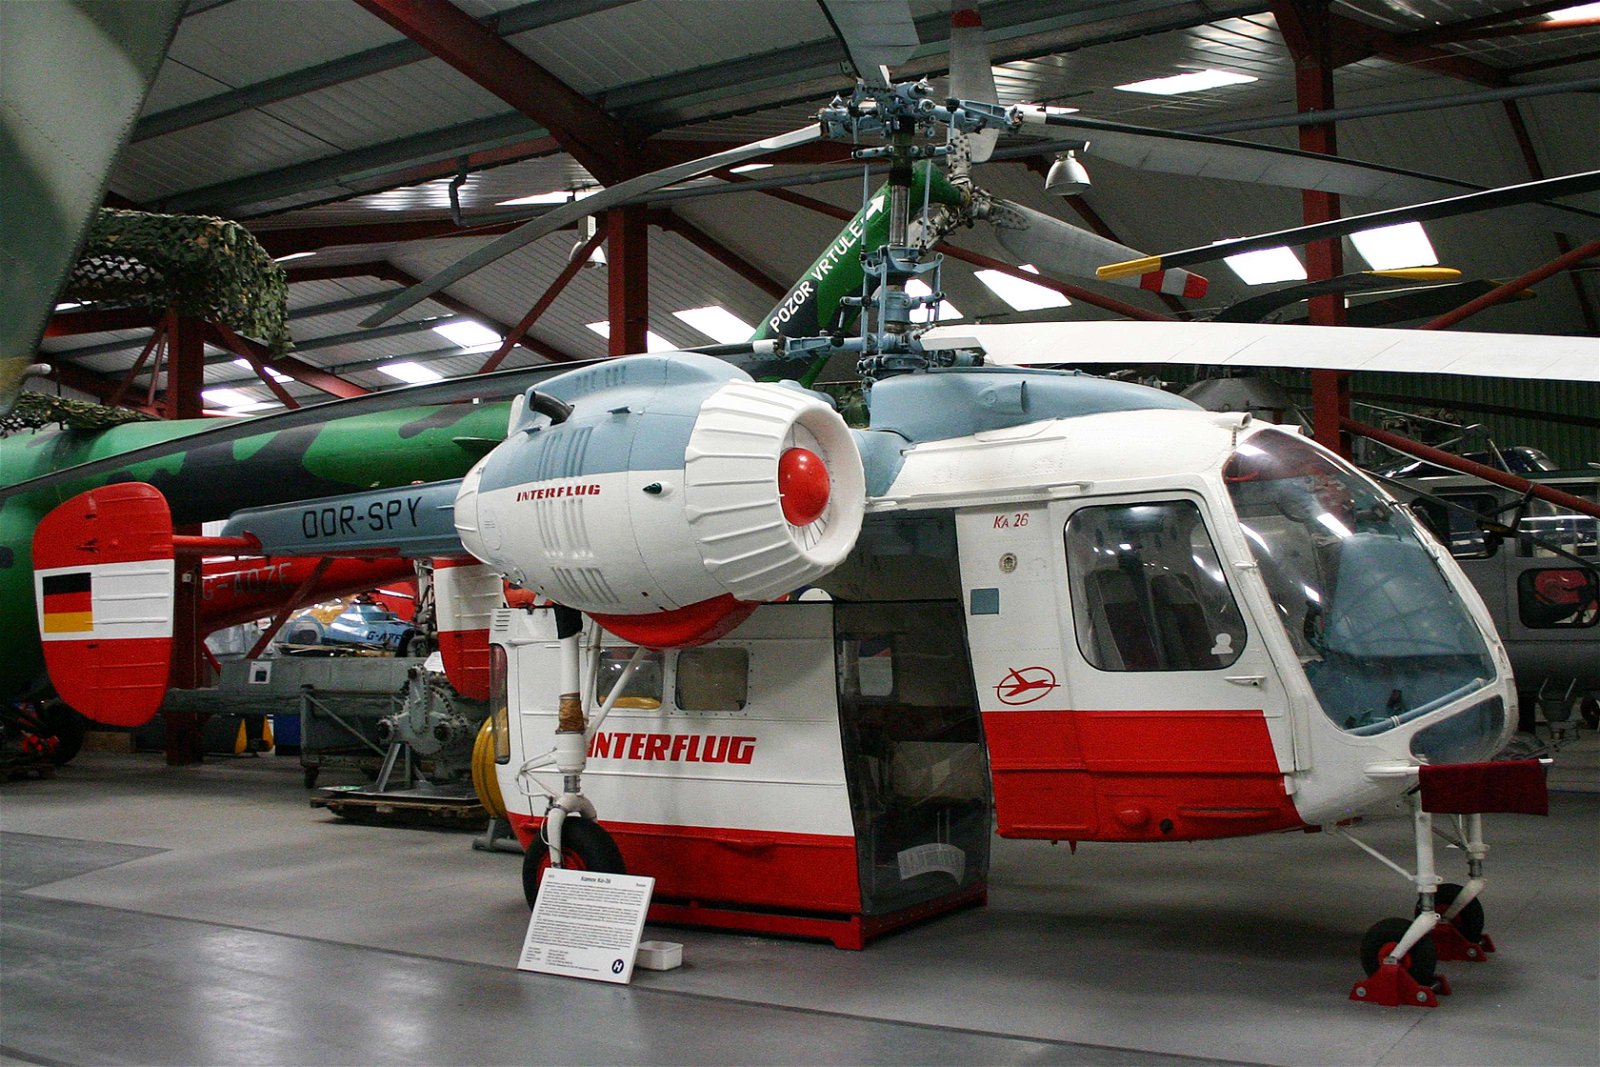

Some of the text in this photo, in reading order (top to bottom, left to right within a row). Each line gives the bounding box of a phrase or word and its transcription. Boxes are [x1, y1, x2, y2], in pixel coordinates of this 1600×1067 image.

[769, 220, 864, 333] POZOR VRTULE
[516, 484, 601, 502] INTERFLUG
[1013, 512, 1029, 527] 26
